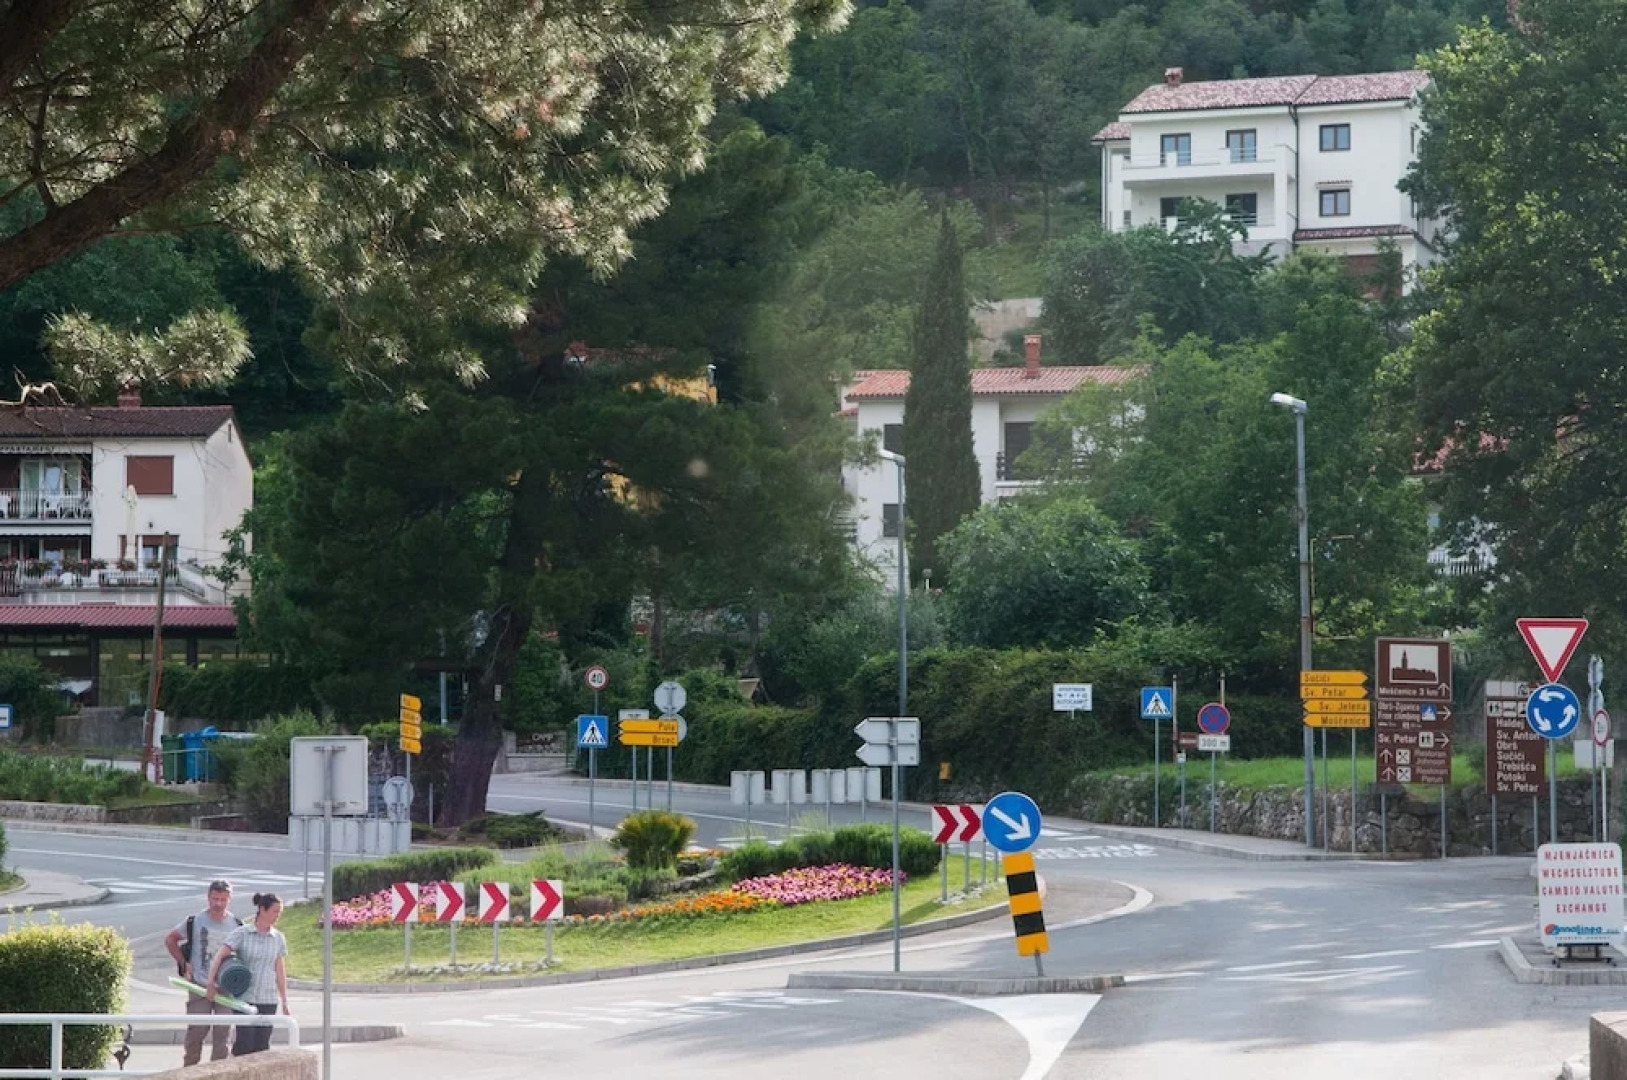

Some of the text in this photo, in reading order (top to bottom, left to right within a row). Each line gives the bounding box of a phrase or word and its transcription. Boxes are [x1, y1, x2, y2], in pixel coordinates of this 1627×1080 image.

[591, 673, 602, 683] 40
[1304, 687, 1347, 697] Sv. Petar
[1419, 687, 1425, 696] 3
[1427, 687, 1439, 696] km
[1319, 701, 1367, 711] Sv. Jelena
[658, 722, 675, 731] Pula
[1377, 733, 1417, 743] Sv. Petar
[1496, 730, 1511, 740] Sv.
[1201, 738, 1218, 748] 300
[1497, 782, 1539, 792] Sv. Petar
[1542, 886, 1581, 896] CAMBIO
[1557, 904, 1606, 913] EXCHANGE
